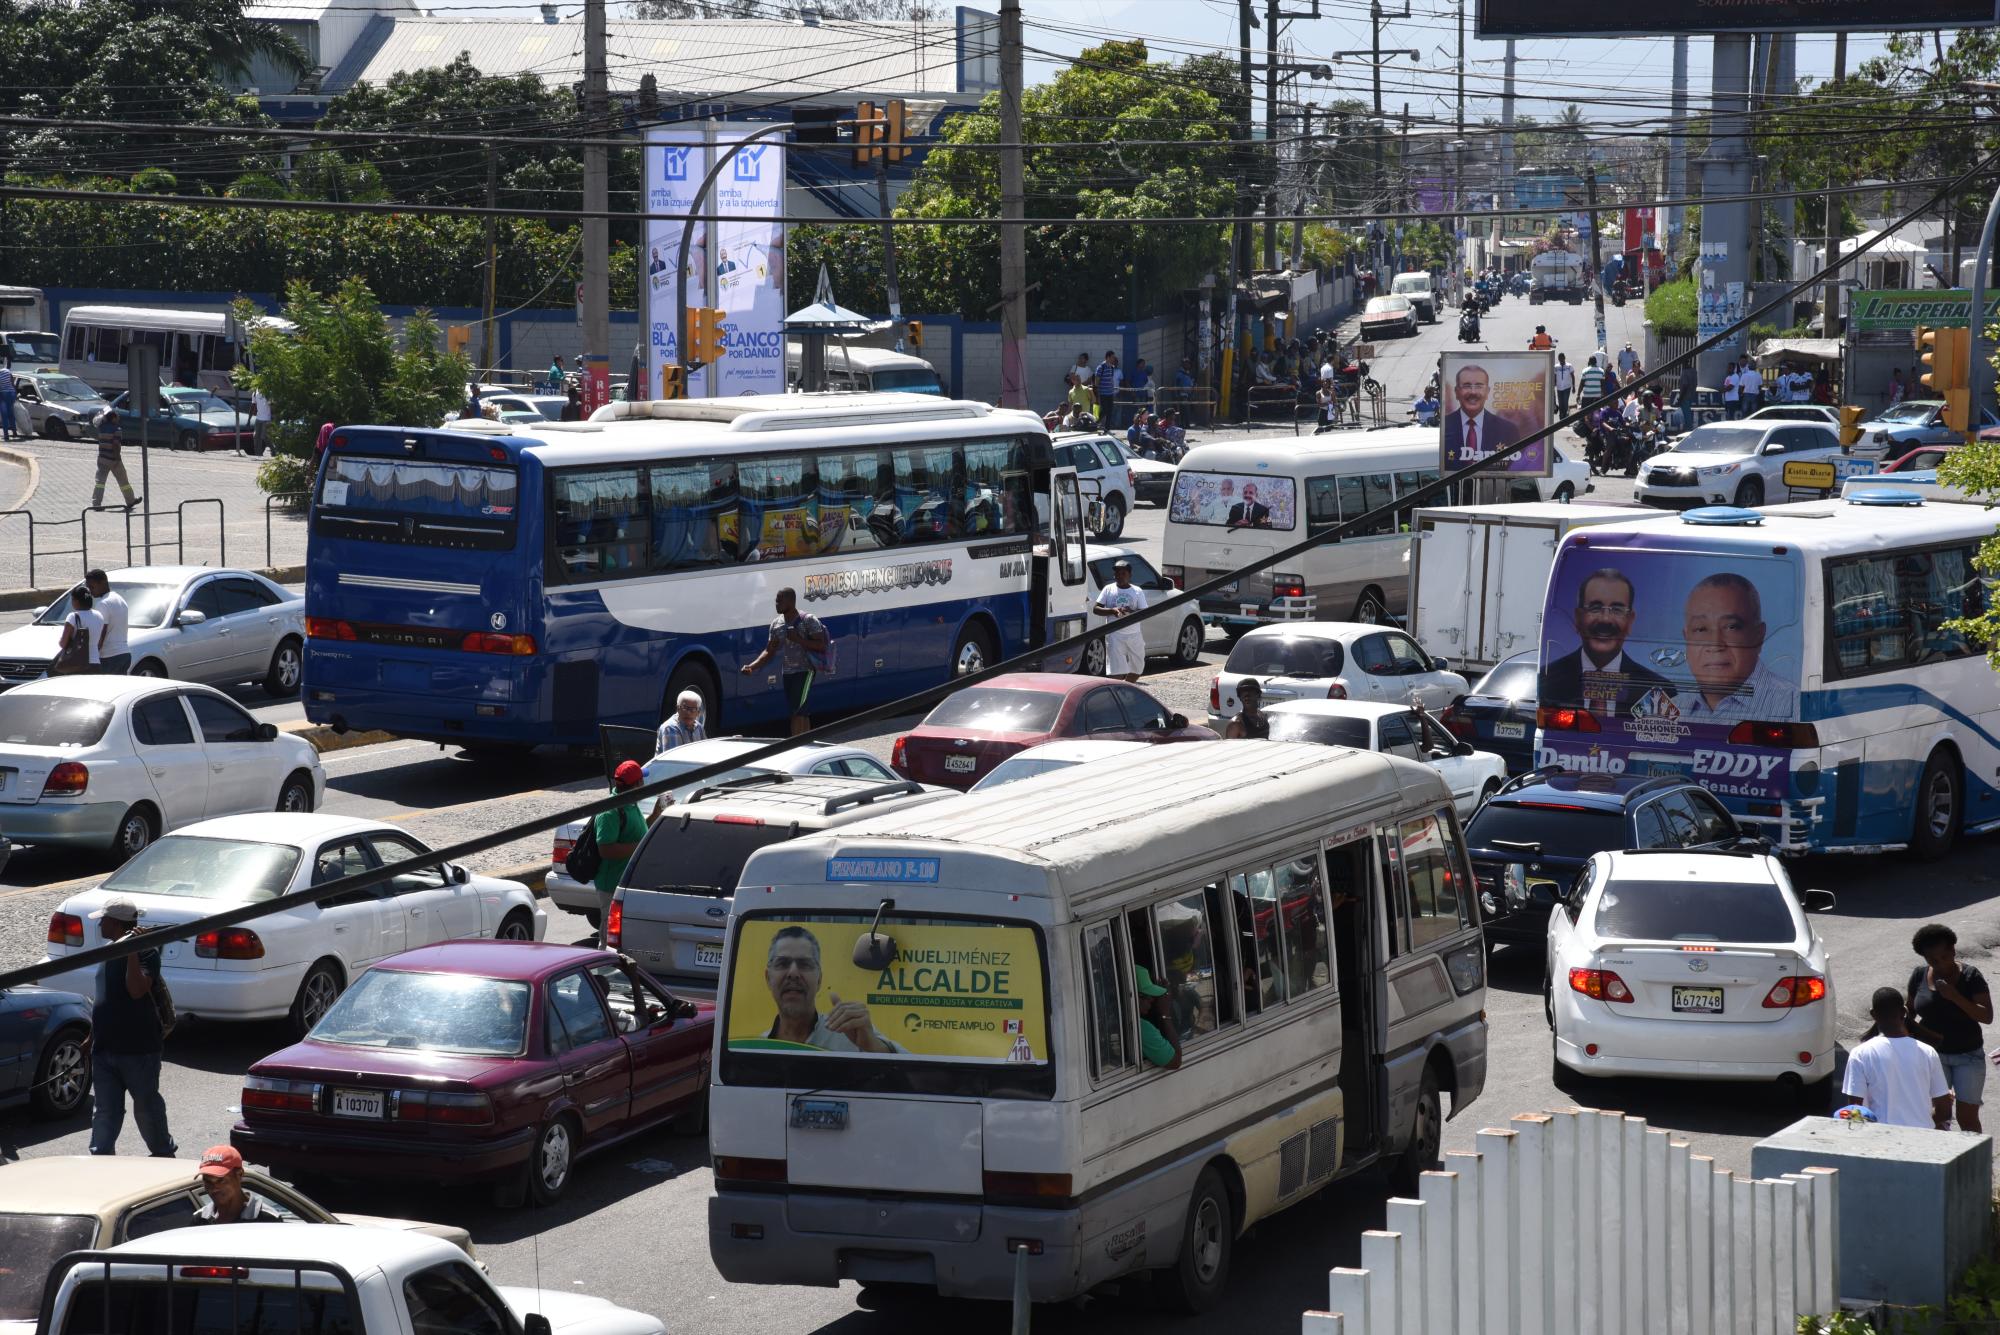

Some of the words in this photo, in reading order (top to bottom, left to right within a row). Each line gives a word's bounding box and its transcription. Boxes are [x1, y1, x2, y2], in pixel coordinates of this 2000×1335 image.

[719, 188, 741, 197] arriba
[732, 198, 740, 207] la
[741, 198, 779, 208] izquierda
[1864, 297, 1892, 318] LA
[652, 322, 669, 330] VOTA
[652, 331, 677, 346] BLA
[720, 332, 780, 347] BLANCO
[660, 348, 674, 358] POR
[729, 350, 743, 358] POR
[744, 347, 780, 358] DANILO
[1493, 381, 1544, 391] SIEMPRE
[1491, 400, 1531, 409] GENTE
[805, 569, 859, 594] EXPRESO
[1583, 690, 1618, 699] GENTE
[1624, 723, 1690, 736] BARAHONERA
[1538, 745, 1626, 774] Danilo
[1692, 749, 1784, 780] EDDY
[1700, 778, 1767, 797] Senador
[876, 967, 1010, 994] ALCALDE
[875, 994, 890, 1003] POR
[892, 994, 909, 1004] UNA
[910, 995, 941, 1005] CIUDAD
[942, 997, 967, 1006] JUSTA
[974, 998, 1013, 1008] CREATIVA
[1675, 995, 1721, 1008] A672748
[1012, 1045, 1031, 1061] 110
